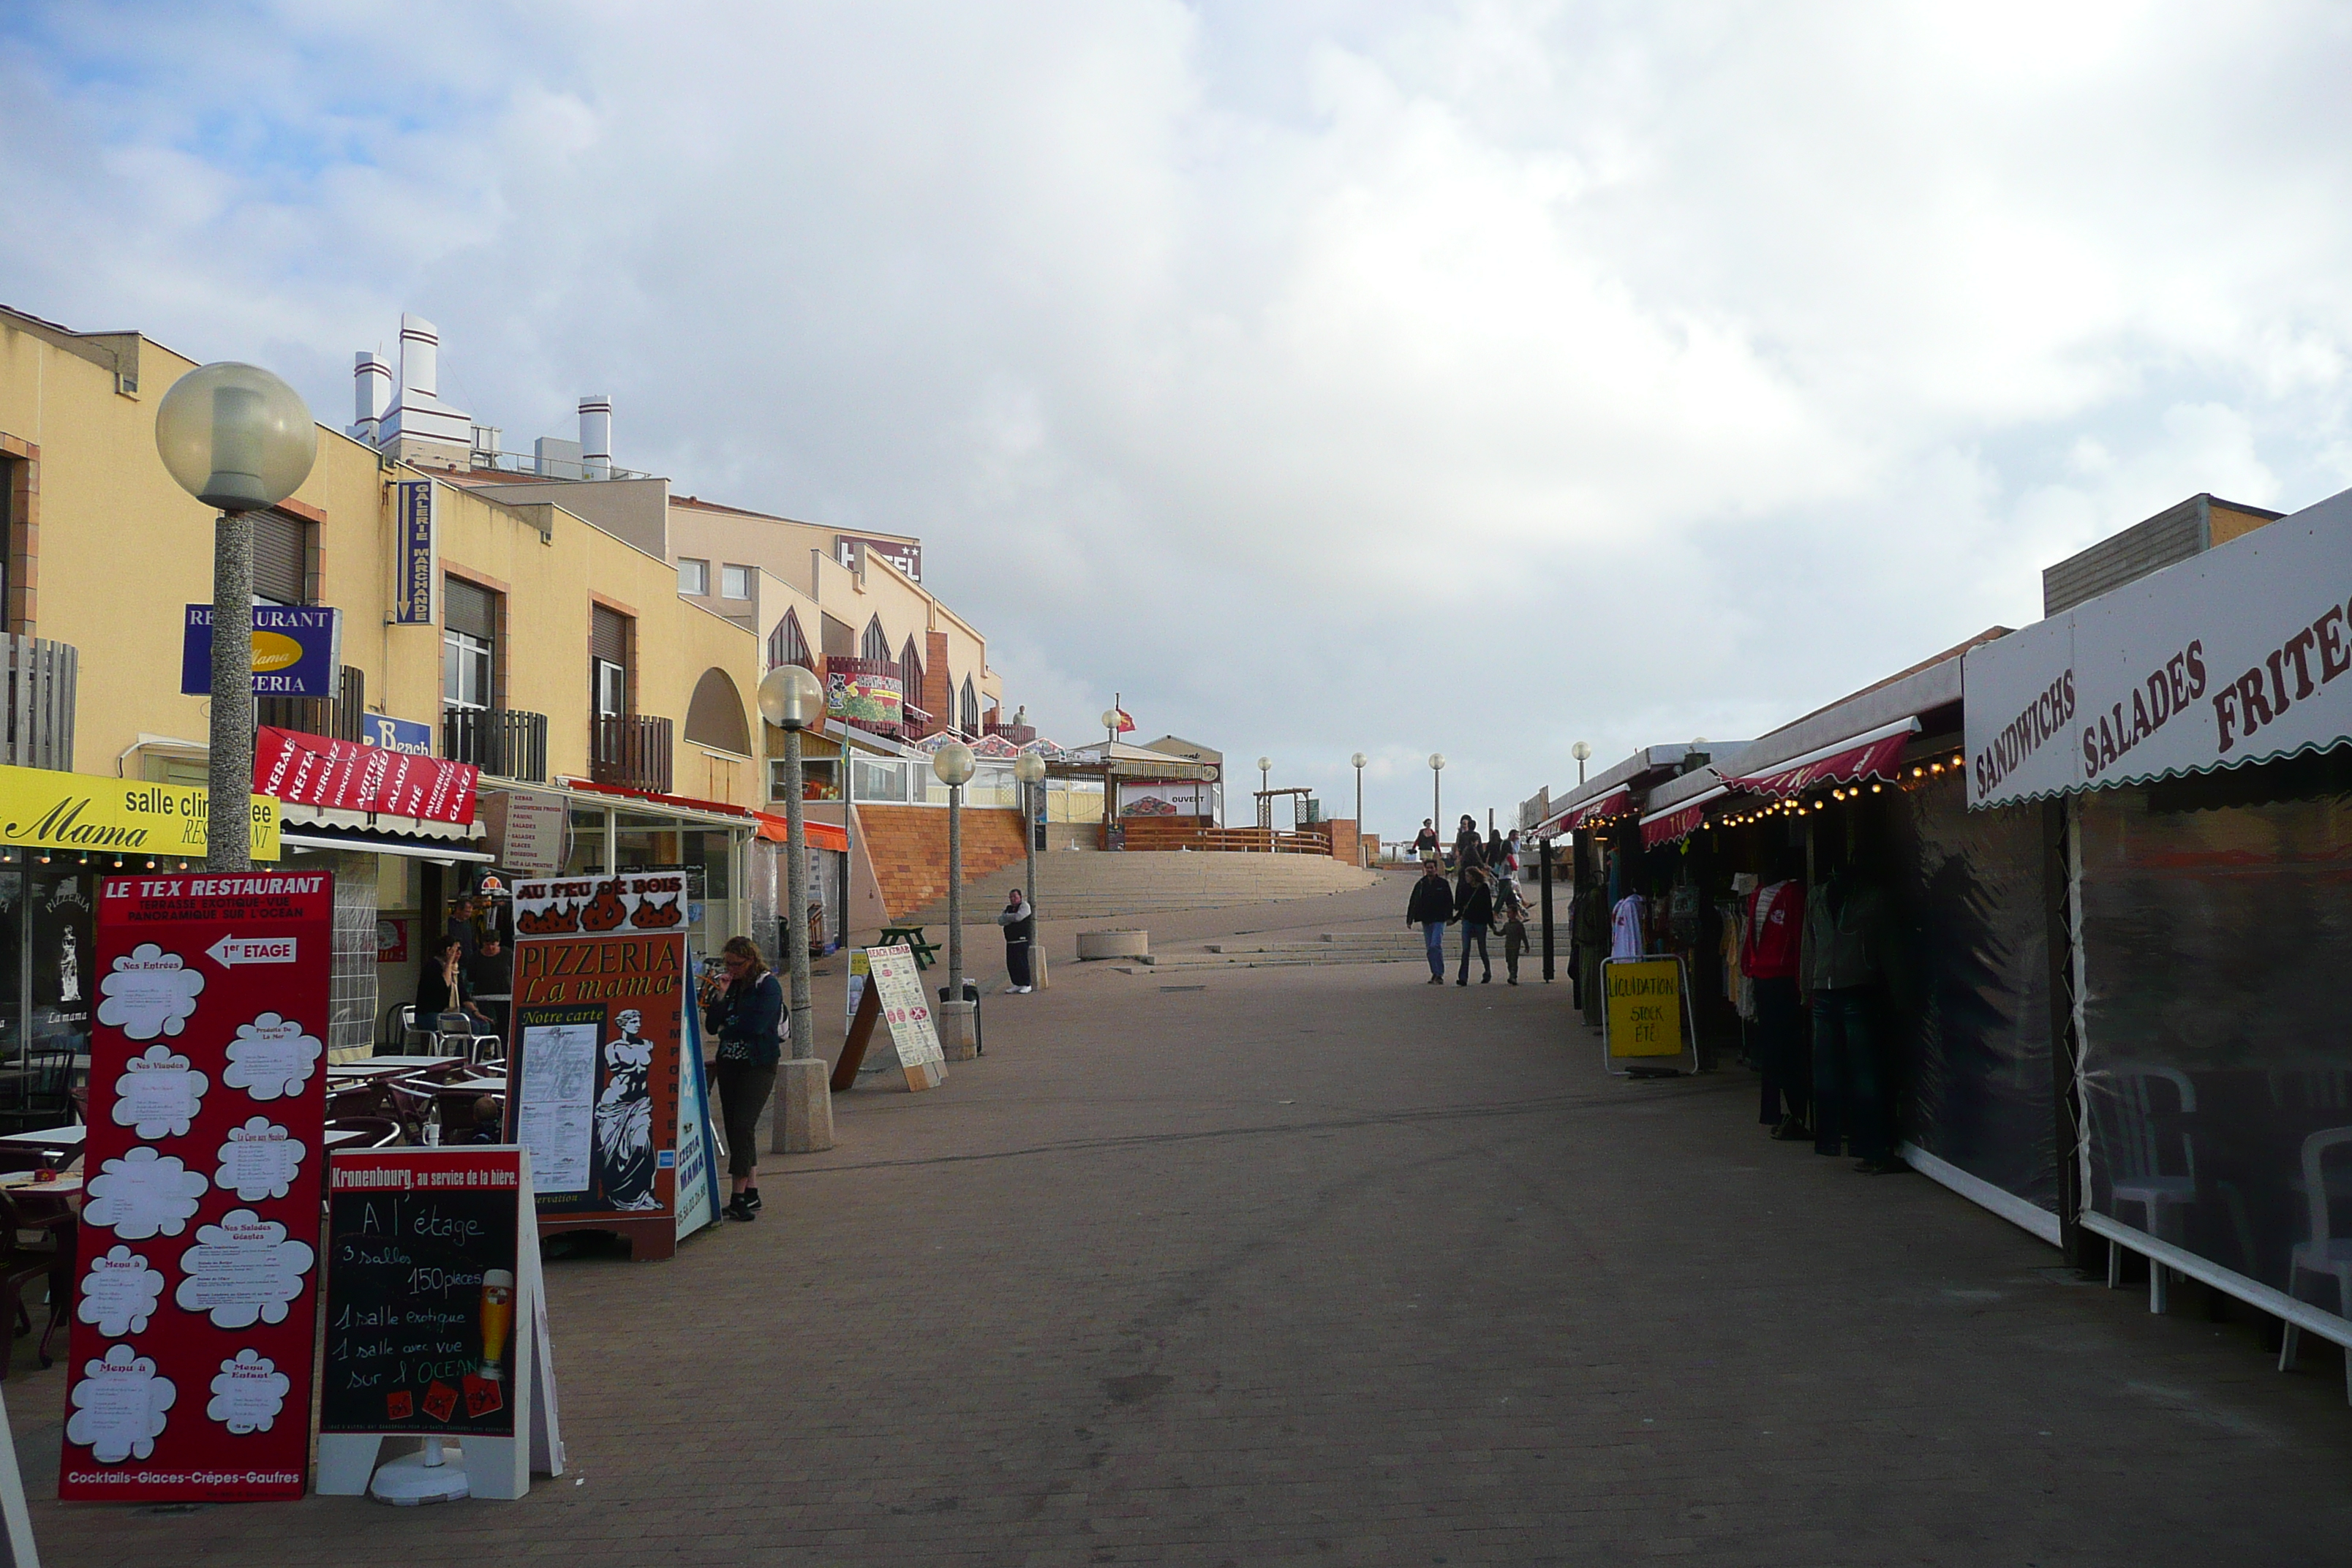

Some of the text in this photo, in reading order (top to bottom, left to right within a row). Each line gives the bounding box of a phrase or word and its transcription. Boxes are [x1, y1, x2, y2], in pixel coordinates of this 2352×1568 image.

[414, 484, 429, 621] GALERIE MARCHANDE
[841, 542, 919, 581] HEL
[190, 610, 328, 627] REURANT
[2082, 638, 2206, 779] SALADES
[377, 720, 429, 756] Beach
[1976, 668, 2075, 799] SANDWICHS
[264, 737, 295, 797] KEBAB
[289, 749, 316, 802] KEFTA
[312, 741, 341, 804] MERGUEZ
[334, 745, 358, 806] BROCHETTES
[387, 755, 410, 813] SALADES
[449, 767, 471, 821] GLACES
[125, 788, 174, 815] salle
[407, 784, 423, 816] THÉ
[5, 796, 149, 848] Mama
[105, 877, 323, 898] LE TEX RESTAURANT
[516, 877, 683, 900] AU FEU DE BOIS
[45, 893, 91, 913] PIZZERIA
[139, 899, 197, 910] TERRASSE
[128, 911, 217, 921] PANORAMIQUE
[222, 910, 245, 919] SUR
[244, 944, 290, 958] ETAGE
[520, 940, 680, 978] PIZZERIA
[889, 945, 910, 954] KEBAB
[143, 961, 179, 970] Entrées
[522, 975, 674, 1005] La mama
[1608, 976, 1675, 998] LIQUIDATION
[48, 1011, 88, 1024] La mama
[521, 1009, 604, 1025] Notre carte
[1630, 1006, 1664, 1022] STOCK
[154, 1061, 184, 1070] Viandes
[332, 1166, 517, 1189] Kronenbourg, au service de la bière.
[363, 1202, 380, 1235] A
[342, 1245, 412, 1264] 3 salles
[334, 1304, 467, 1333] 1 salle exotique
[331, 1338, 463, 1361] 1 salle avec vue
[99, 1364, 134, 1372] Menu
[346, 1371, 382, 1390] sur
